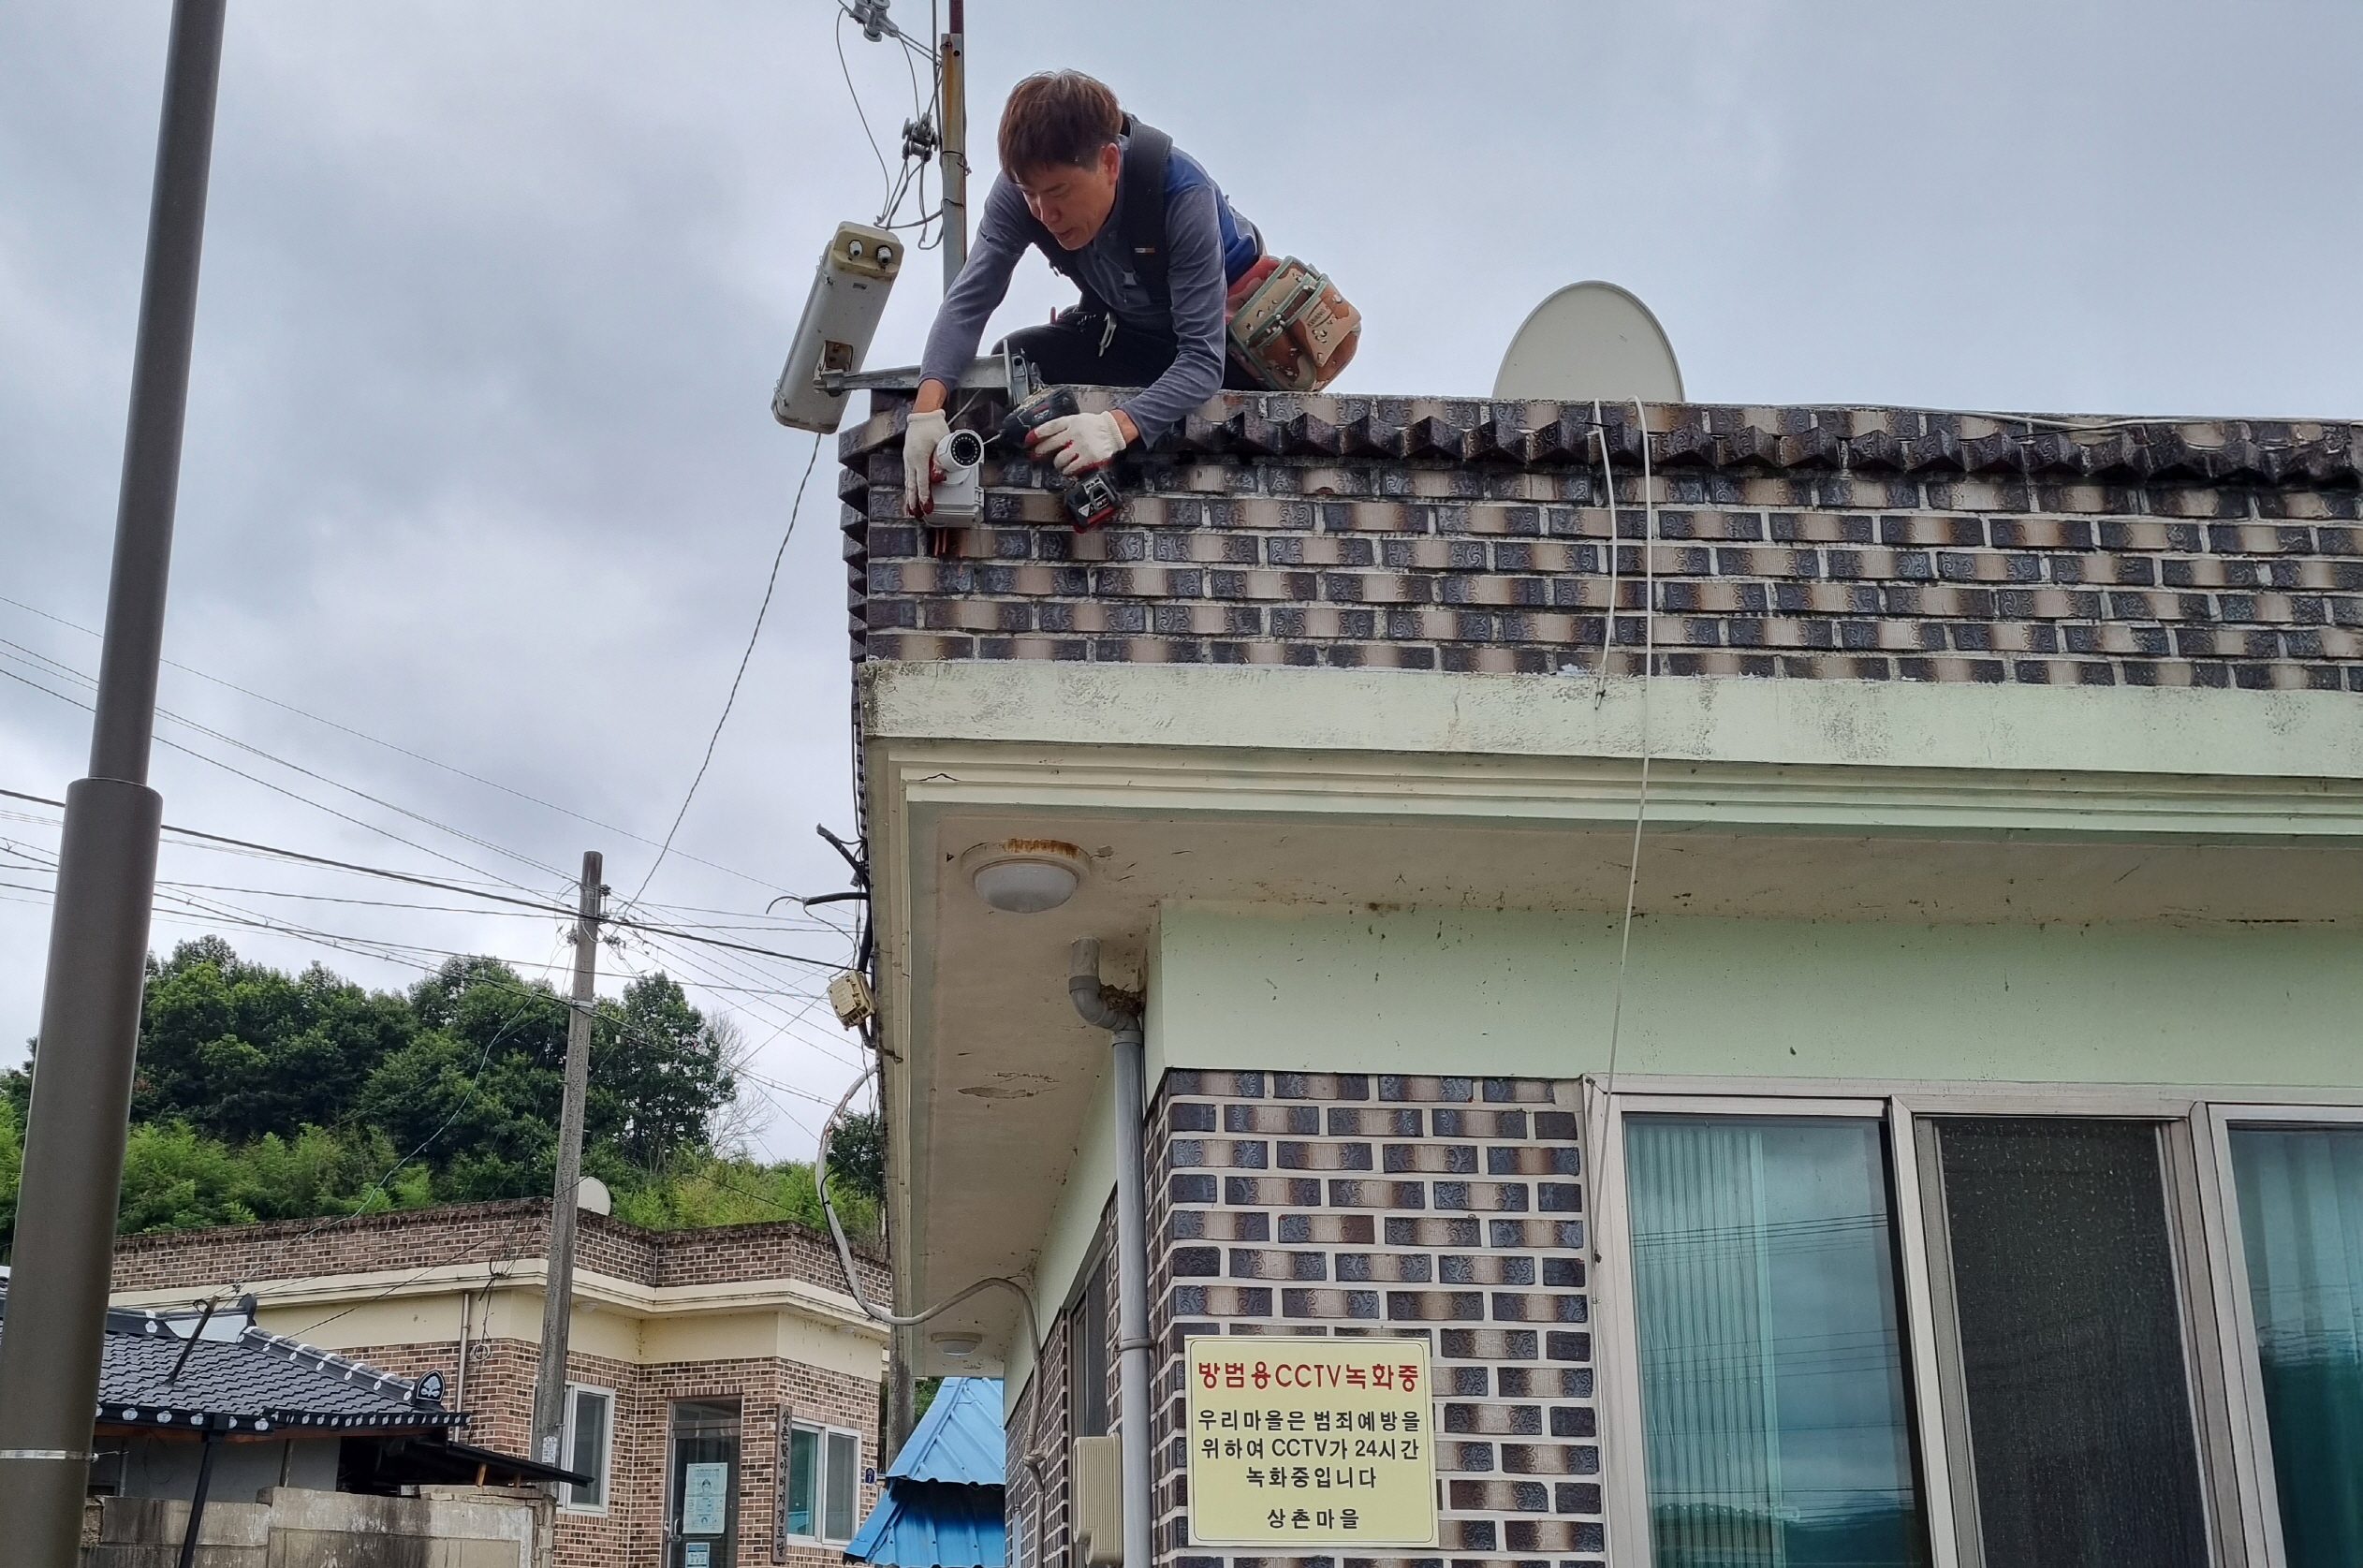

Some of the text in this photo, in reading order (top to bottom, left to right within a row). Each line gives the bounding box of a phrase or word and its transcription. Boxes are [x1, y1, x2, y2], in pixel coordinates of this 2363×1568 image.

[1198, 1361, 1419, 1392] 방범용CCTV녹화중
[1198, 1410, 1420, 1432] 우리마을은 범죄예방을
[1201, 1438, 1419, 1460] 위하여 CCTV가 24시간
[1245, 1466, 1376, 1488] 녹화중입니다
[1267, 1508, 1359, 1530] 상촌마을
